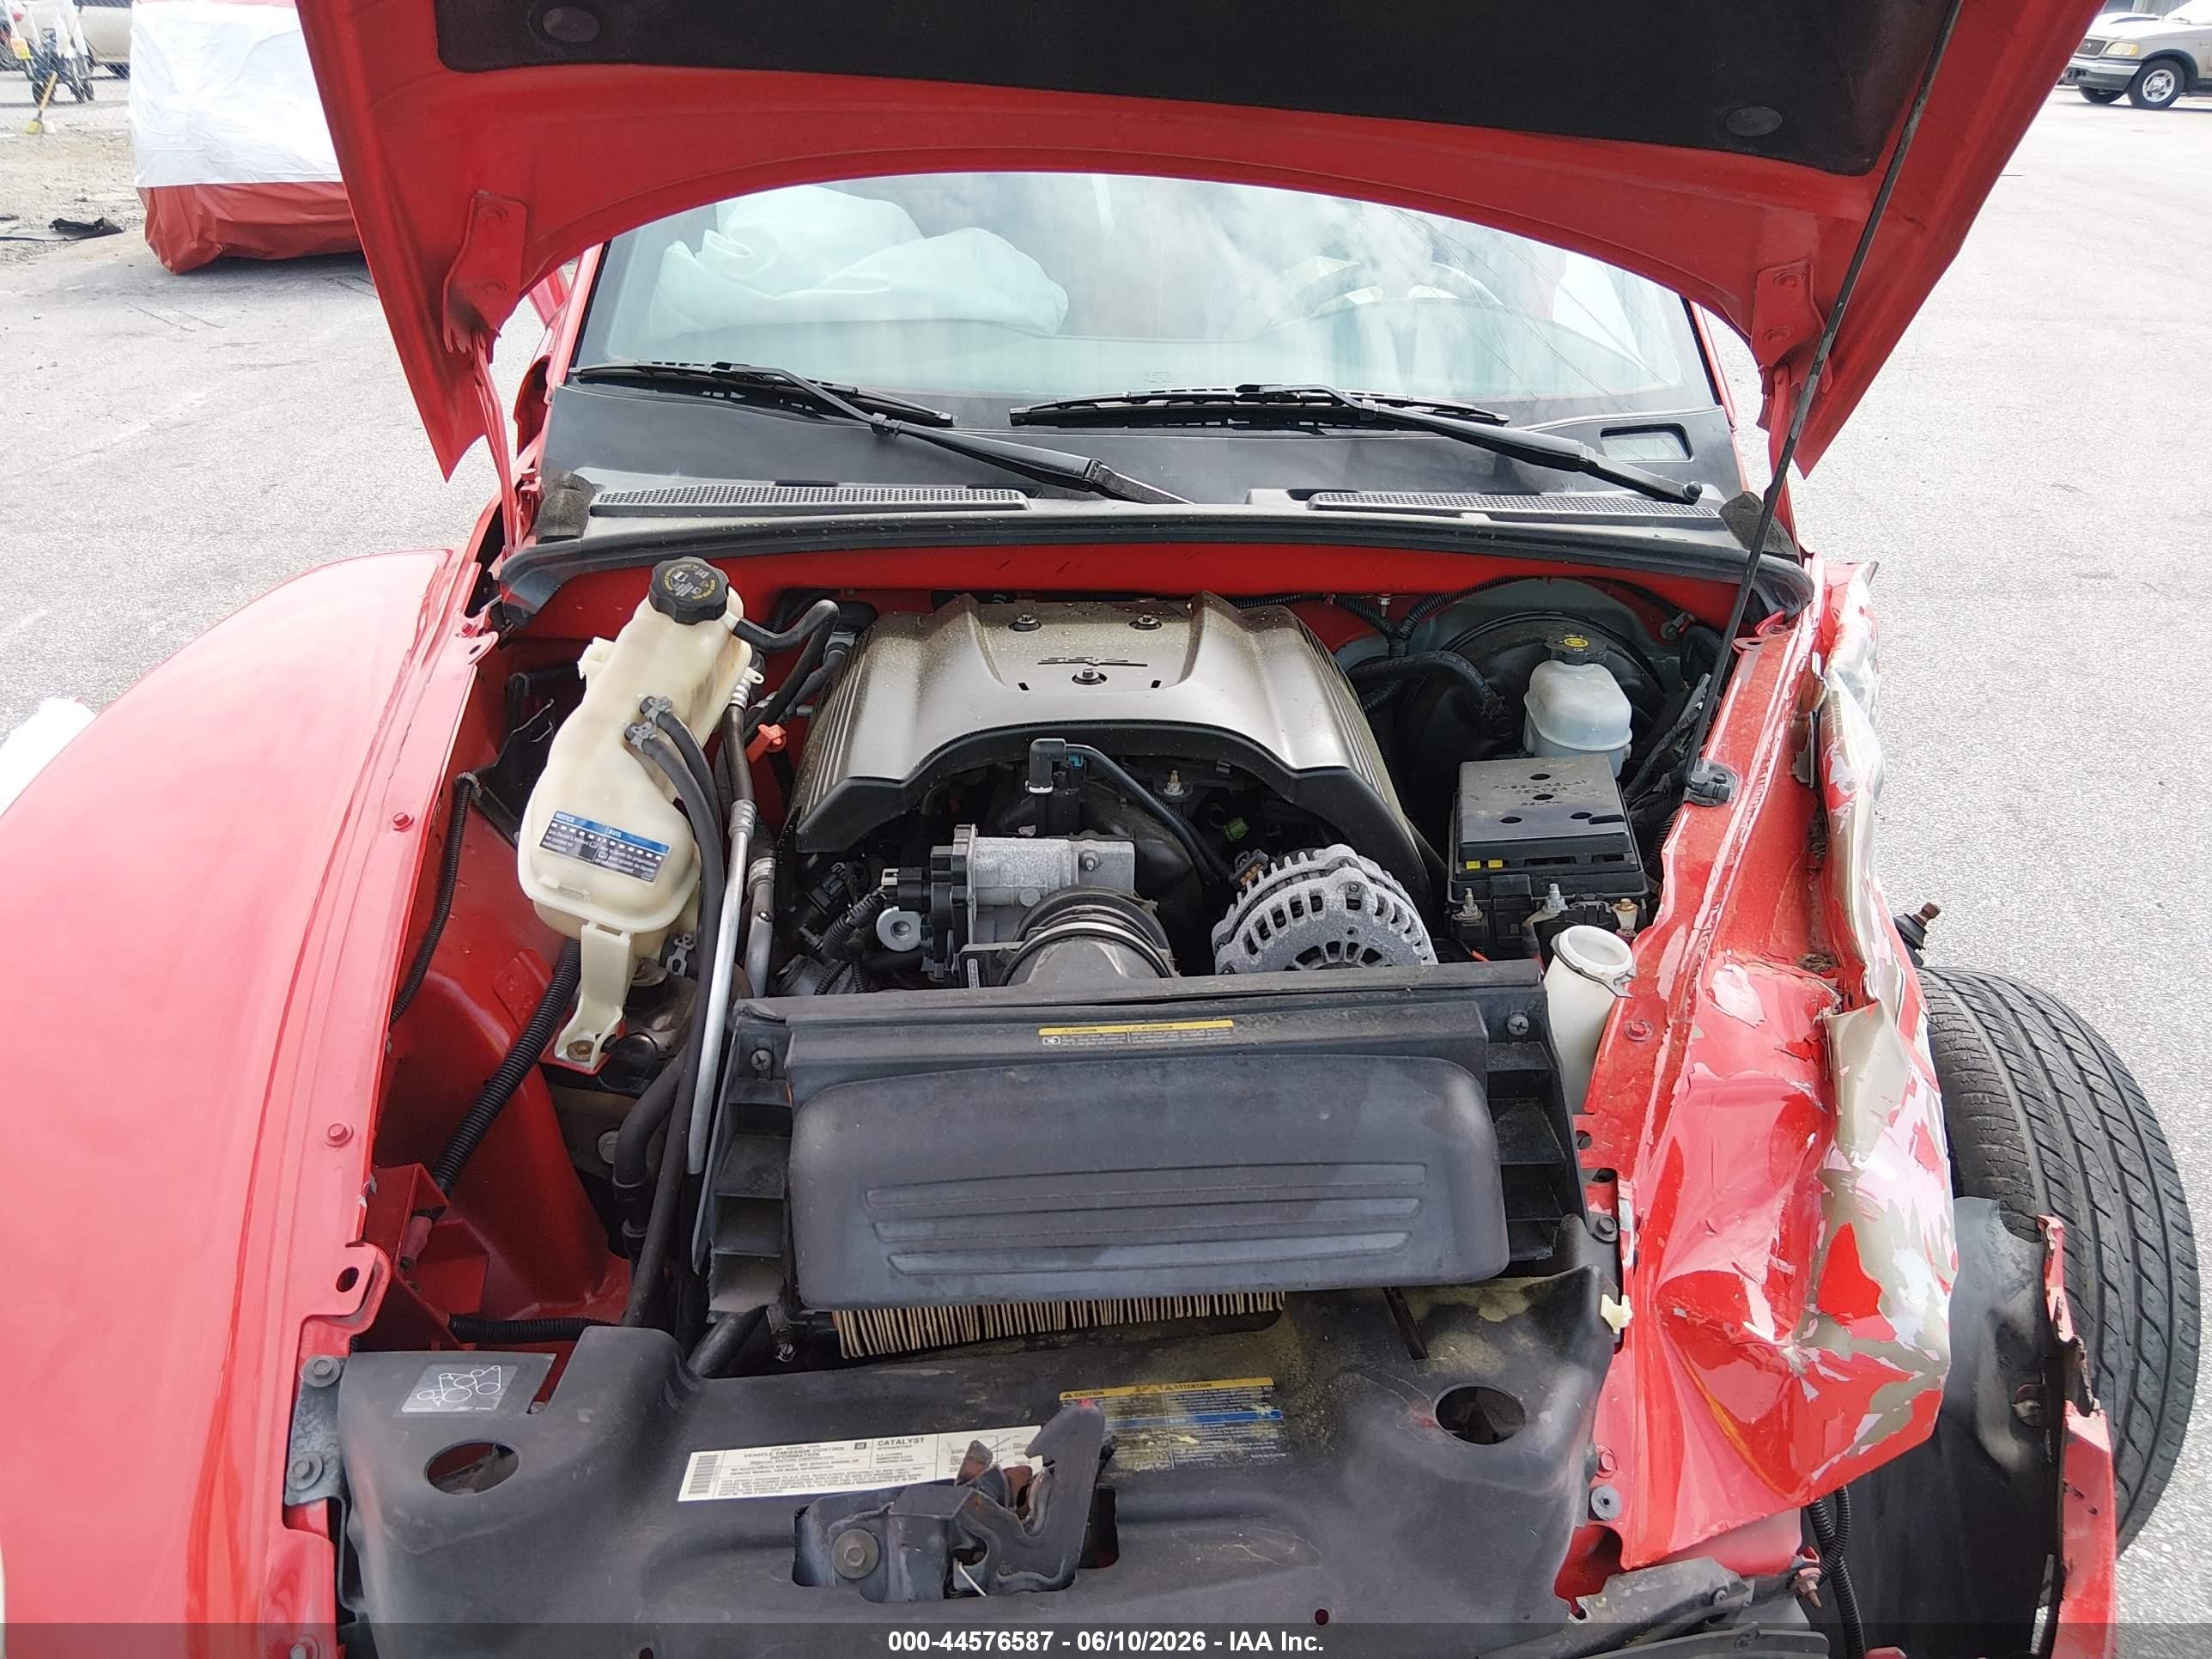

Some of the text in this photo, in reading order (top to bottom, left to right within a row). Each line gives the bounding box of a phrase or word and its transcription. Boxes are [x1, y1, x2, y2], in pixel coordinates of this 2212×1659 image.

[1544, 780, 1589, 788] RELAY
[608, 829, 623, 839] AVIS
[1173, 1382, 1213, 1391] ATTENTION
[878, 1437, 926, 1447] CATALYST
[770, 1452, 821, 1461] INFORMATION
